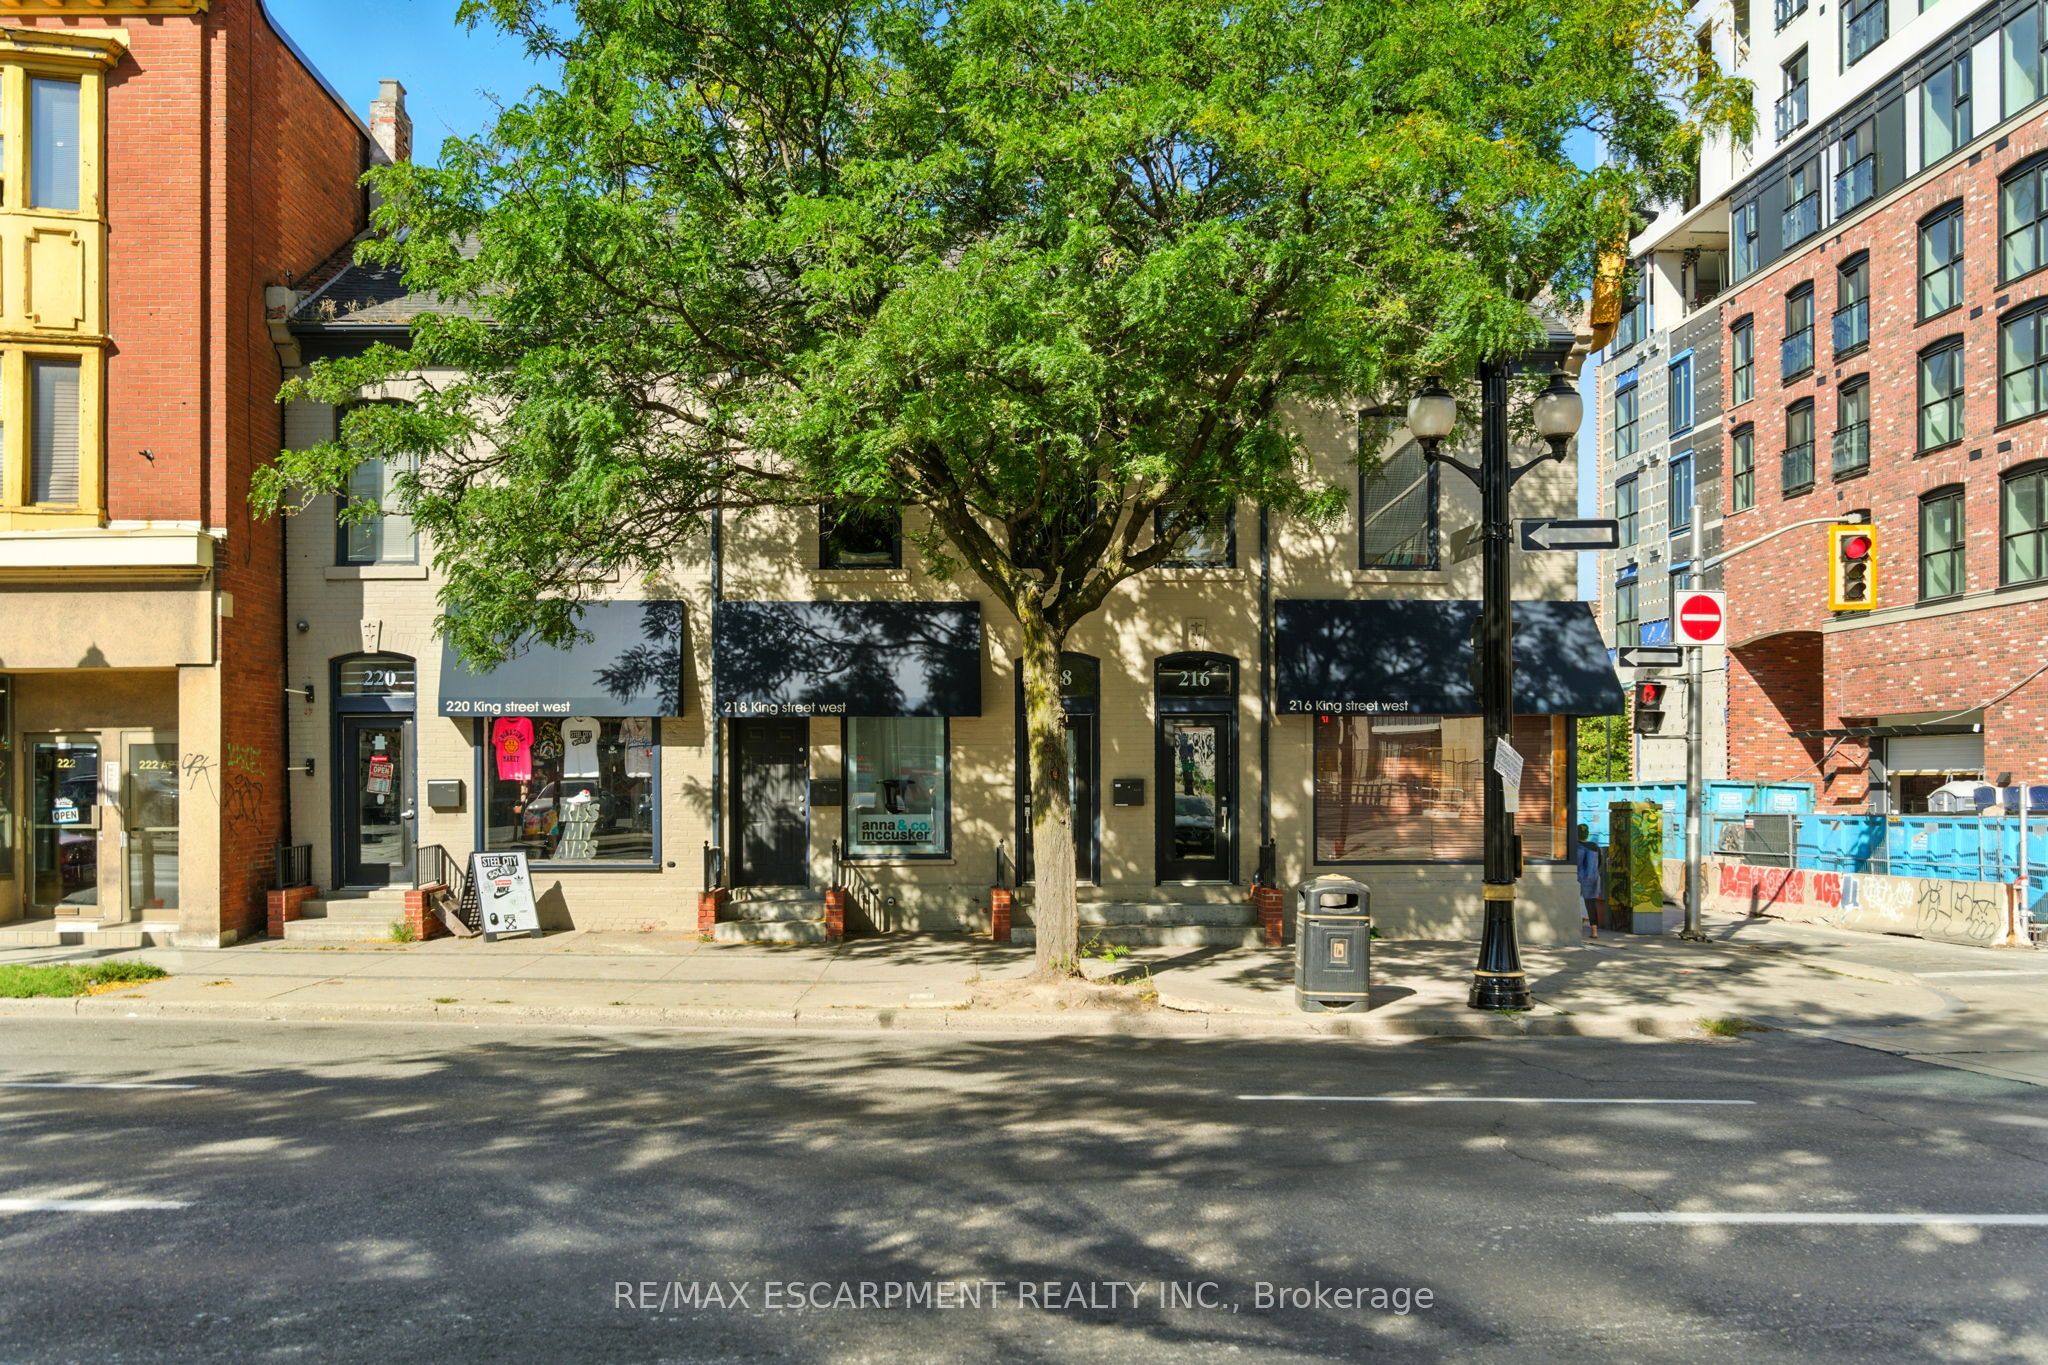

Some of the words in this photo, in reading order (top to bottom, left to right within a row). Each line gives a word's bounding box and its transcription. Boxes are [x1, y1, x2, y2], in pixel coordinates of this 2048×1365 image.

[363, 670, 396, 686] 220
[1178, 670, 1210, 687] 216
[446, 700, 470, 713] 220
[474, 700, 502, 715] King
[504, 701, 539, 713] street
[542, 701, 570, 713] west
[724, 701, 748, 713] 218
[751, 701, 779, 715] King
[781, 702, 815, 713] street
[819, 702, 846, 713] west
[1289, 700, 1312, 711] 216
[1315, 700, 1342, 714] King
[1345, 700, 1378, 711] street
[1381, 701, 1408, 711] west
[57, 759, 75, 768] 222
[139, 760, 159, 769] 222
[373, 766, 390, 774] OPEN
[54, 810, 77, 821] OPEN
[559, 801, 600, 822] KISS
[562, 822, 597, 840] MY
[862, 821, 896, 831] anna
[897, 819, 907, 831] &
[911, 822, 930, 831] co.
[862, 829, 930, 840] mccusker
[552, 840, 599, 860] AIRS
[481, 857, 502, 867] STEEL
[502, 856, 518, 866] CITY
